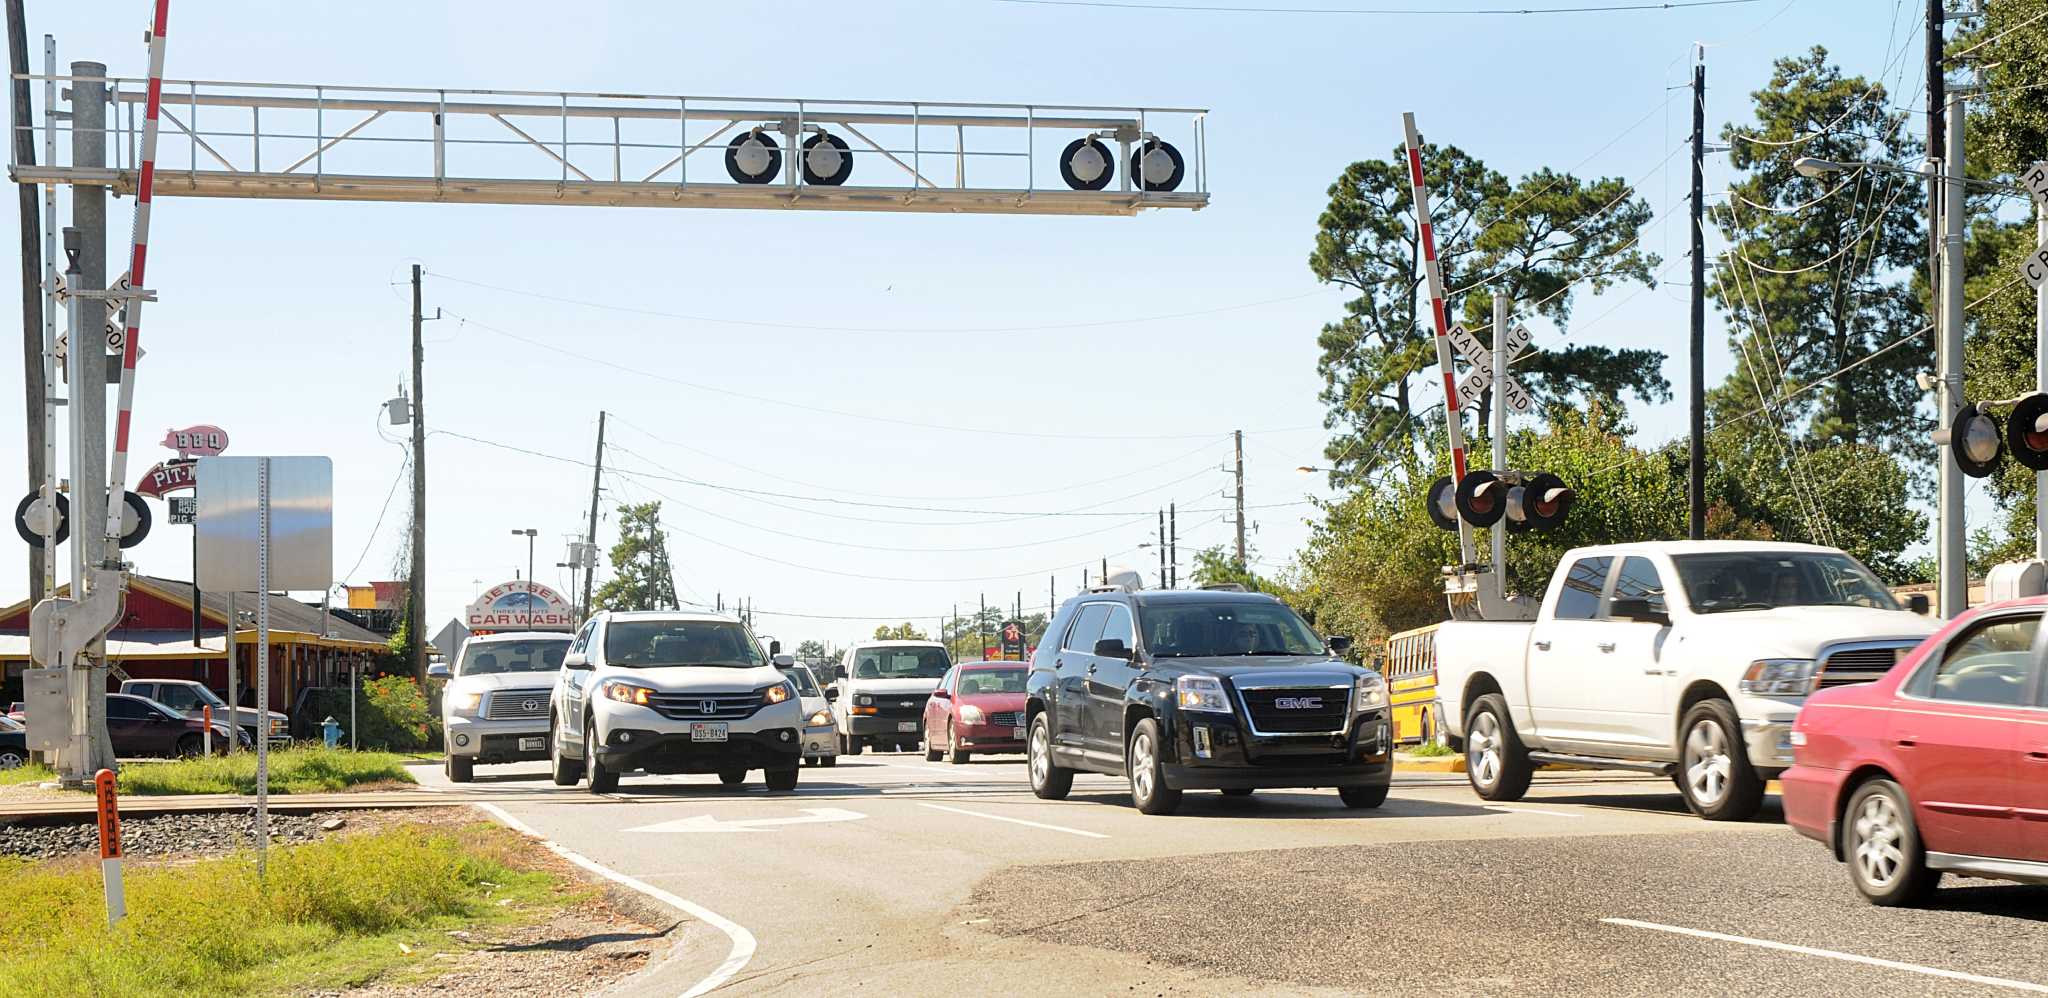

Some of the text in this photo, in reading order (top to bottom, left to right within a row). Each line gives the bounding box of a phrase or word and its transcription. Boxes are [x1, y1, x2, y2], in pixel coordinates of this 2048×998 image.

[176, 432, 221, 449] BBQ
[170, 515, 188, 523] PIG
[484, 583, 562, 606] JET SET
[470, 614, 571, 625] CAR WASH
[1275, 697, 1323, 709] GMC
